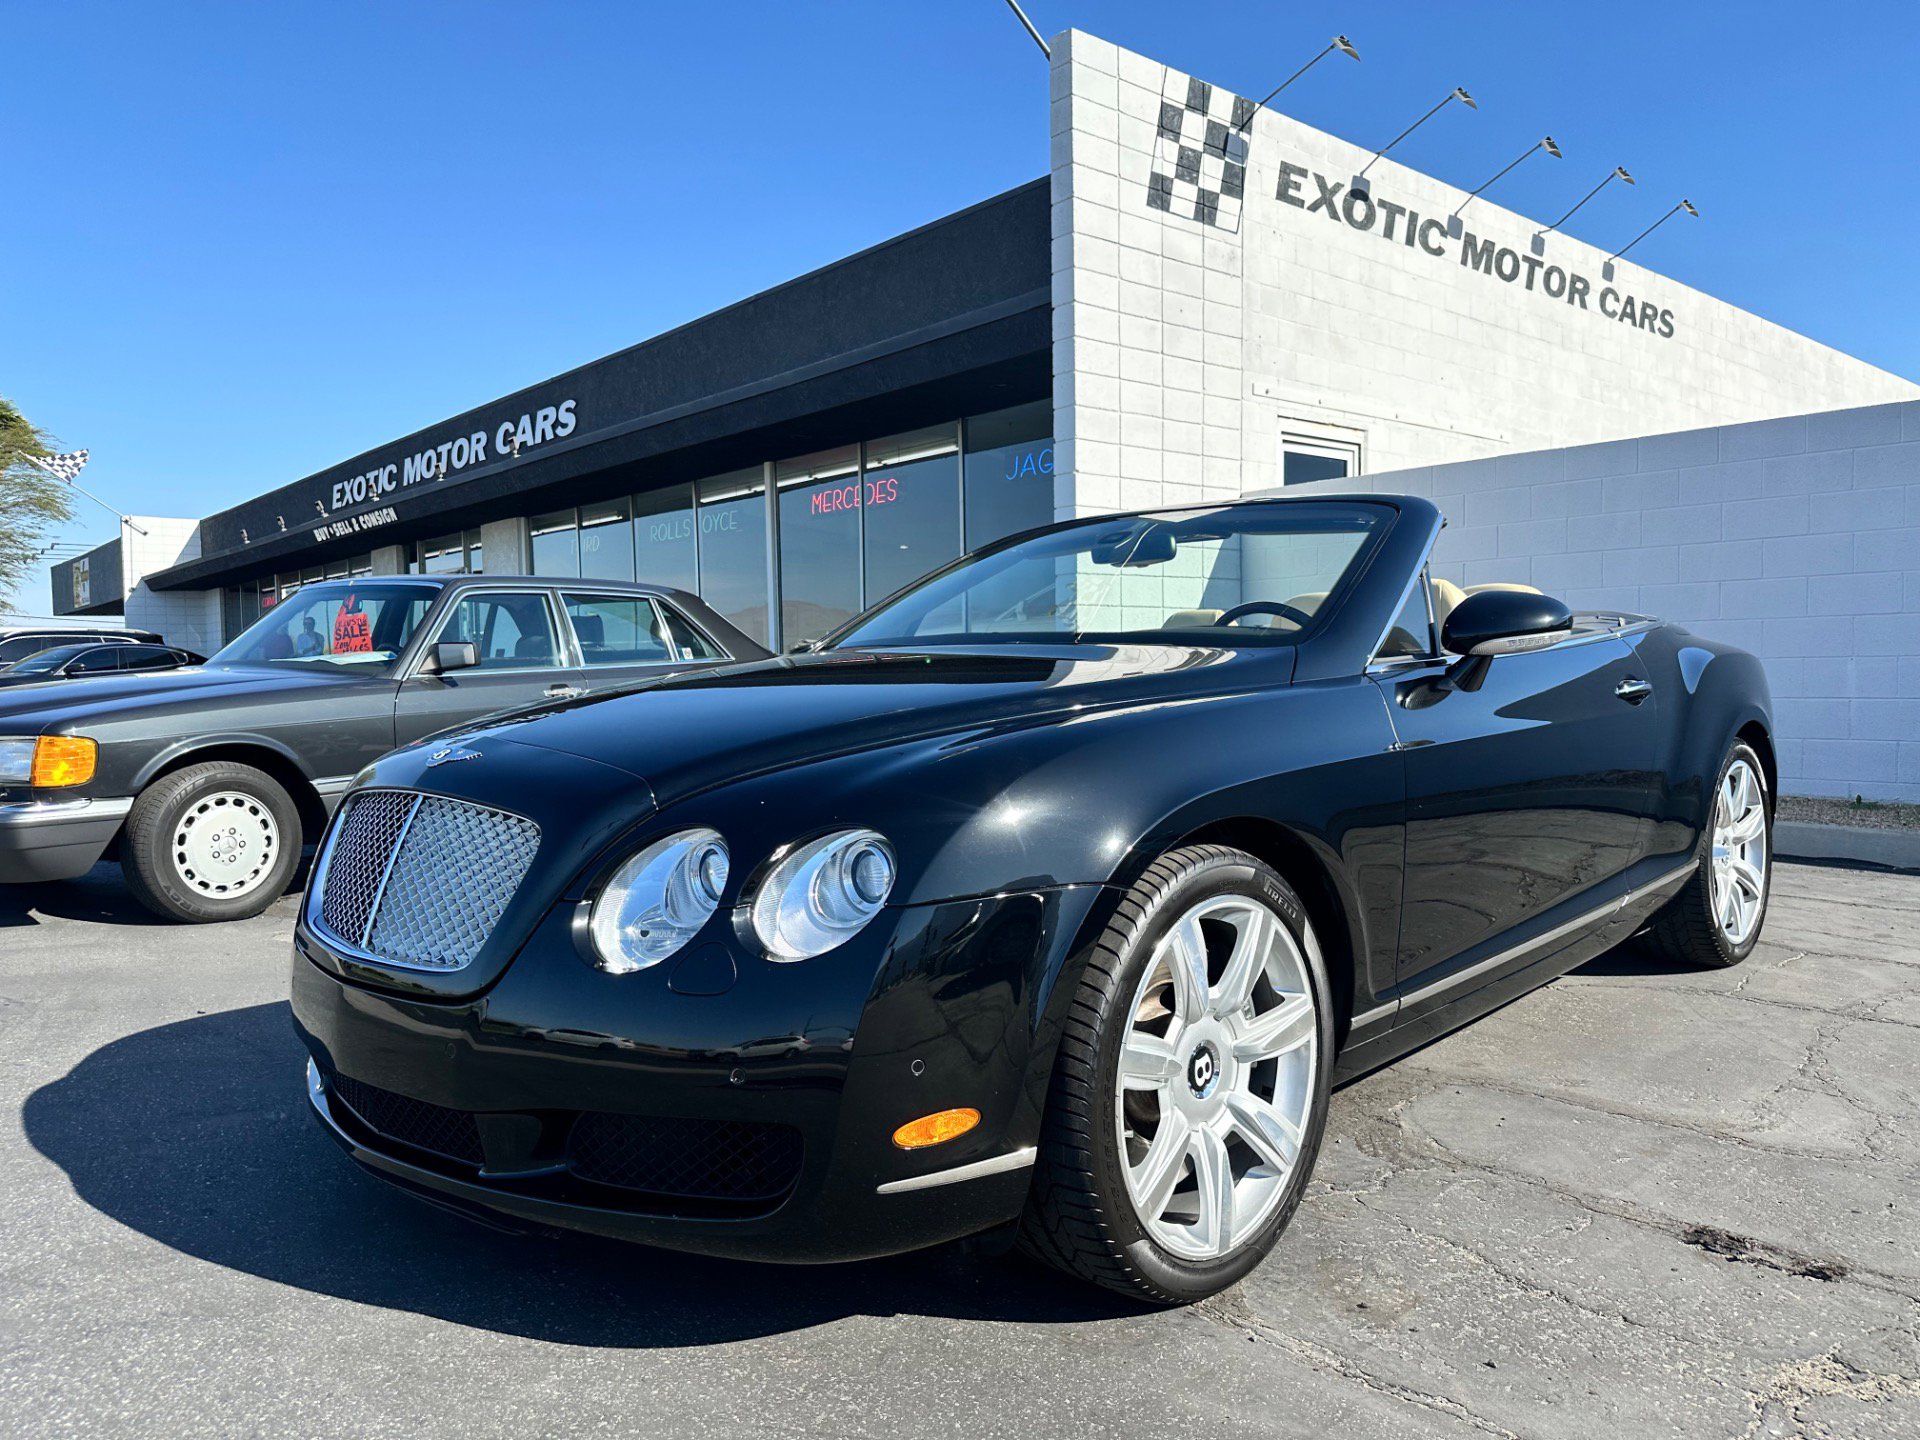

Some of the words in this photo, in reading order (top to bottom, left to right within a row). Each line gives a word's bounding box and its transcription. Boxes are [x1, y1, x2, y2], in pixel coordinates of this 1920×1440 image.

[1275, 160, 1449, 257] EXOTIC
[1460, 231, 1590, 310] MOTOR
[1598, 286, 1675, 339] CARS
[331, 463, 398, 510] EXOTIC
[403, 431, 488, 487] MOTOR
[495, 399, 577, 455] CARS
[313, 526, 331, 542] BUY
[332, 520, 353, 537] SELL
[351, 517, 360, 532] &
[358, 507, 398, 530] CONSIGN
[650, 518, 692, 543] ROLLS
[701, 510, 738, 534] OYCE
[334, 622, 369, 641] SALE
